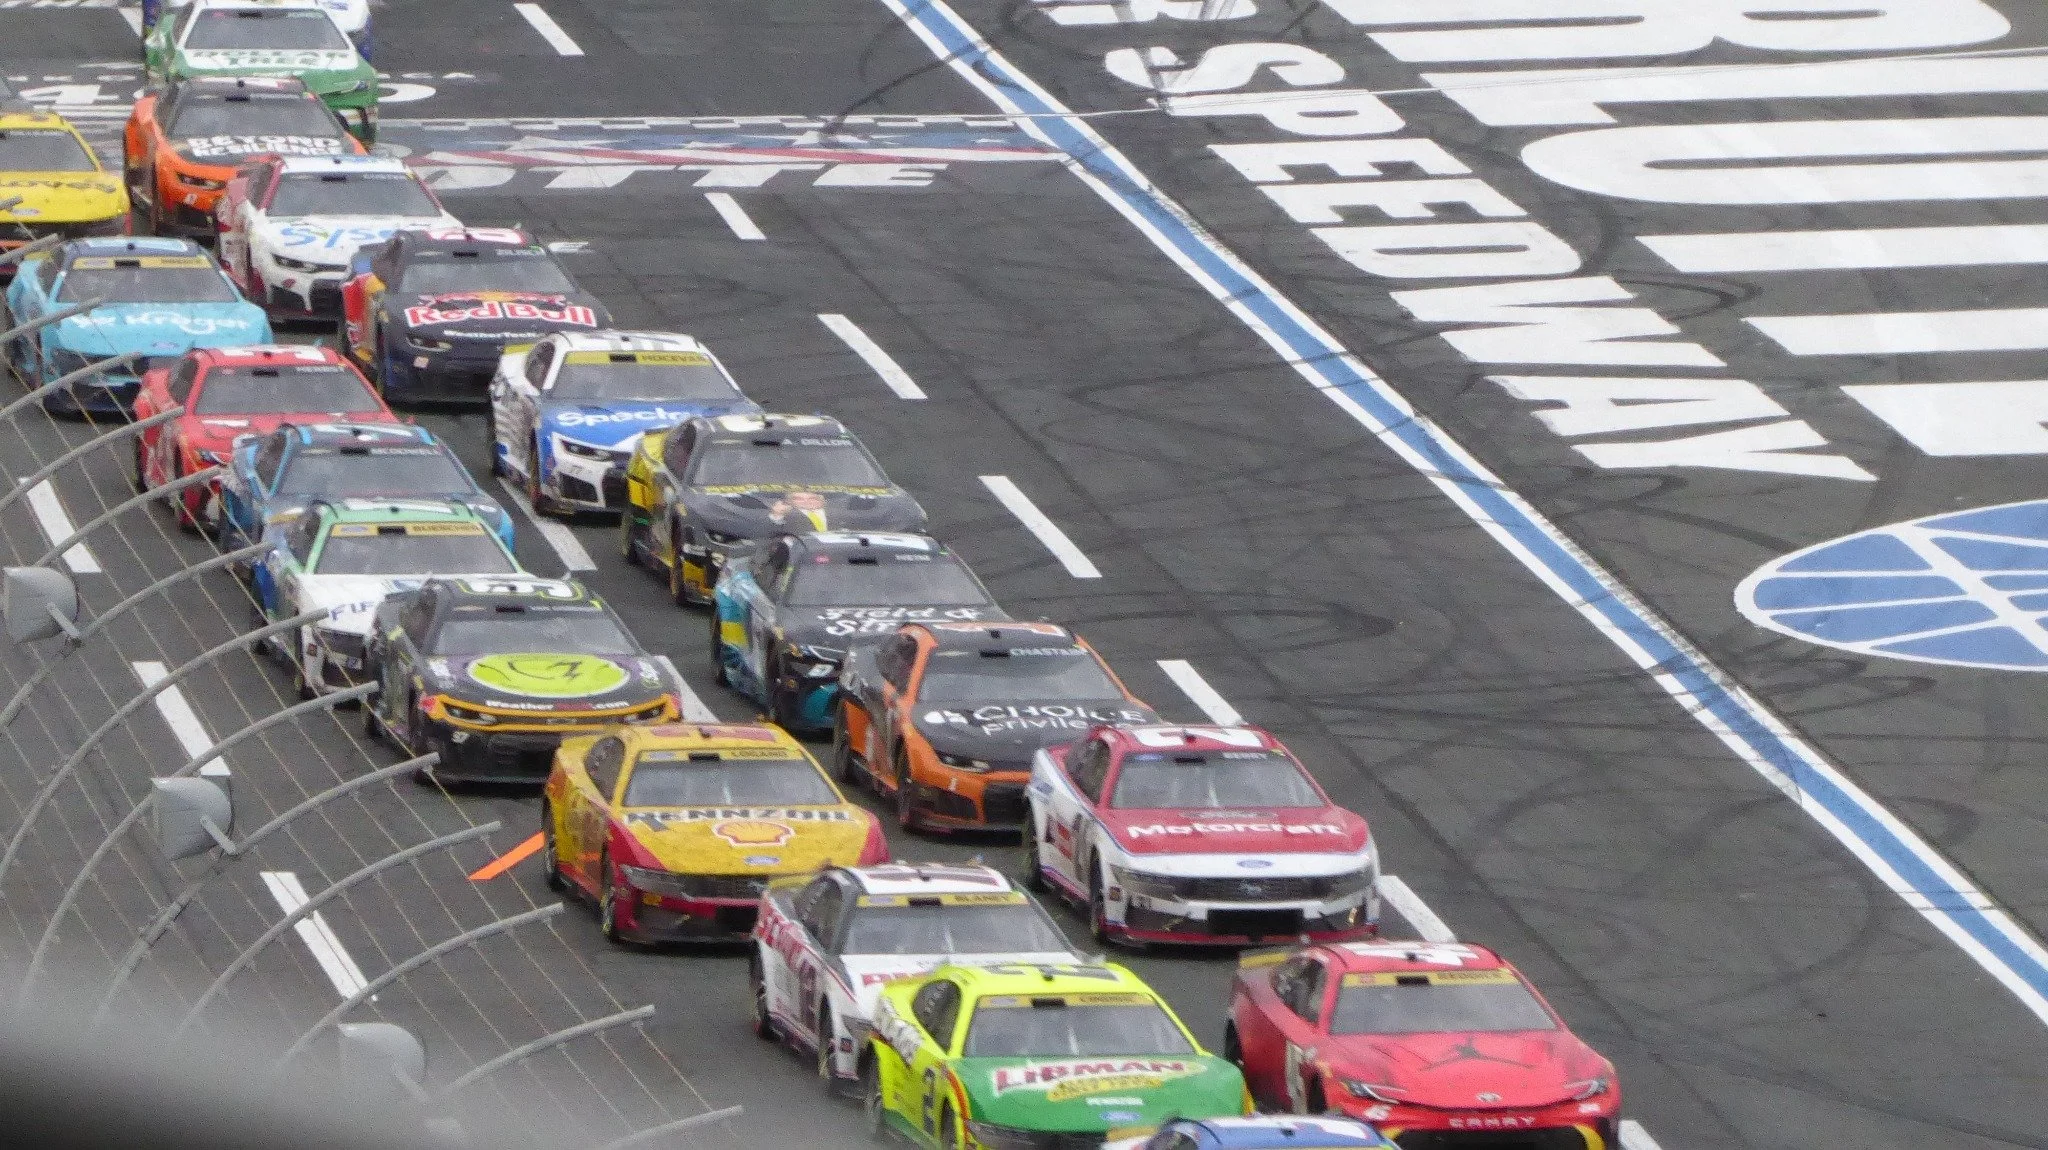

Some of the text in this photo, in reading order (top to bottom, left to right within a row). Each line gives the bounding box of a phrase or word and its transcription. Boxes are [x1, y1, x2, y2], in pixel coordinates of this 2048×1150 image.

[187, 136, 341, 149] BEYOND
[1104, 42, 1878, 482] SPEEDWAY
[405, 301, 598, 328] Red Bull
[973, 706, 1146, 723] CHOICE
[1126, 822, 1345, 839] Motorcraft
[1448, 1115, 1536, 1128] CAMRY
